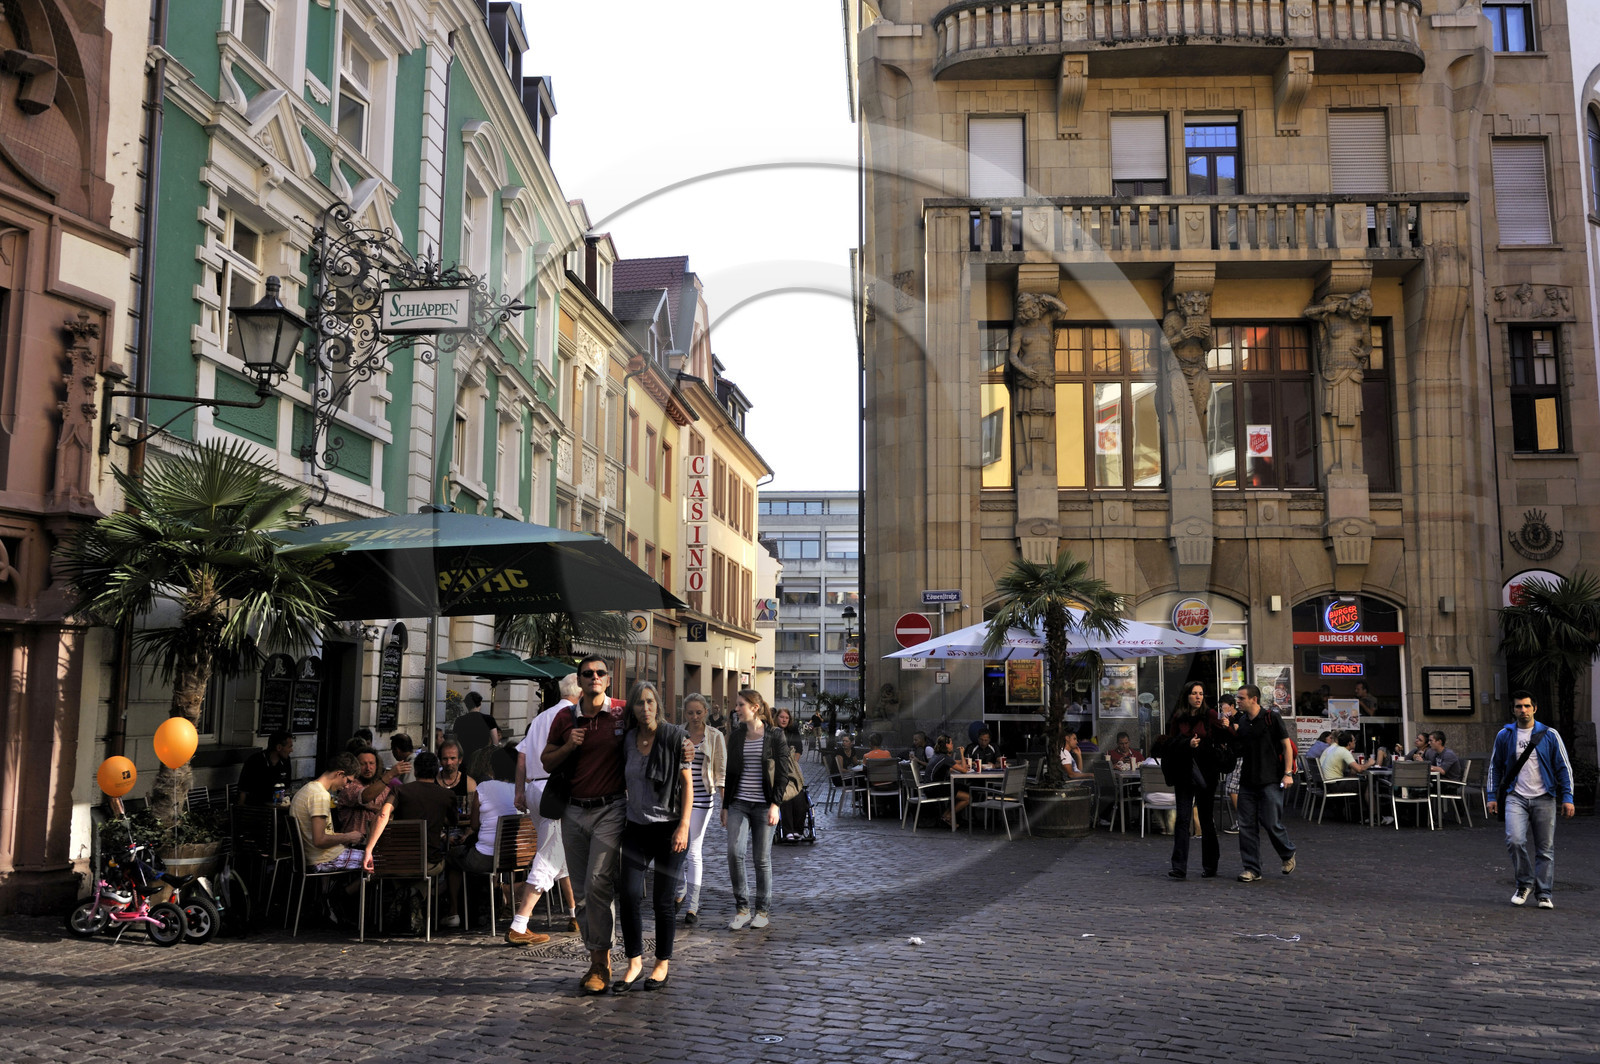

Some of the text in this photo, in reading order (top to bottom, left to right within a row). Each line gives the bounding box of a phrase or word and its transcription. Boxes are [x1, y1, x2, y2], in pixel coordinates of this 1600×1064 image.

[390, 293, 460, 317] SCHLAPPEN
[689, 456, 705, 591] CASINO
[320, 528, 441, 542] JEVER
[1177, 608, 1209, 618] BURGER
[1328, 605, 1357, 619] BURGER
[1176, 616, 1210, 627] KING
[1330, 613, 1358, 628] KING
[1322, 664, 1362, 673] INTERNET
